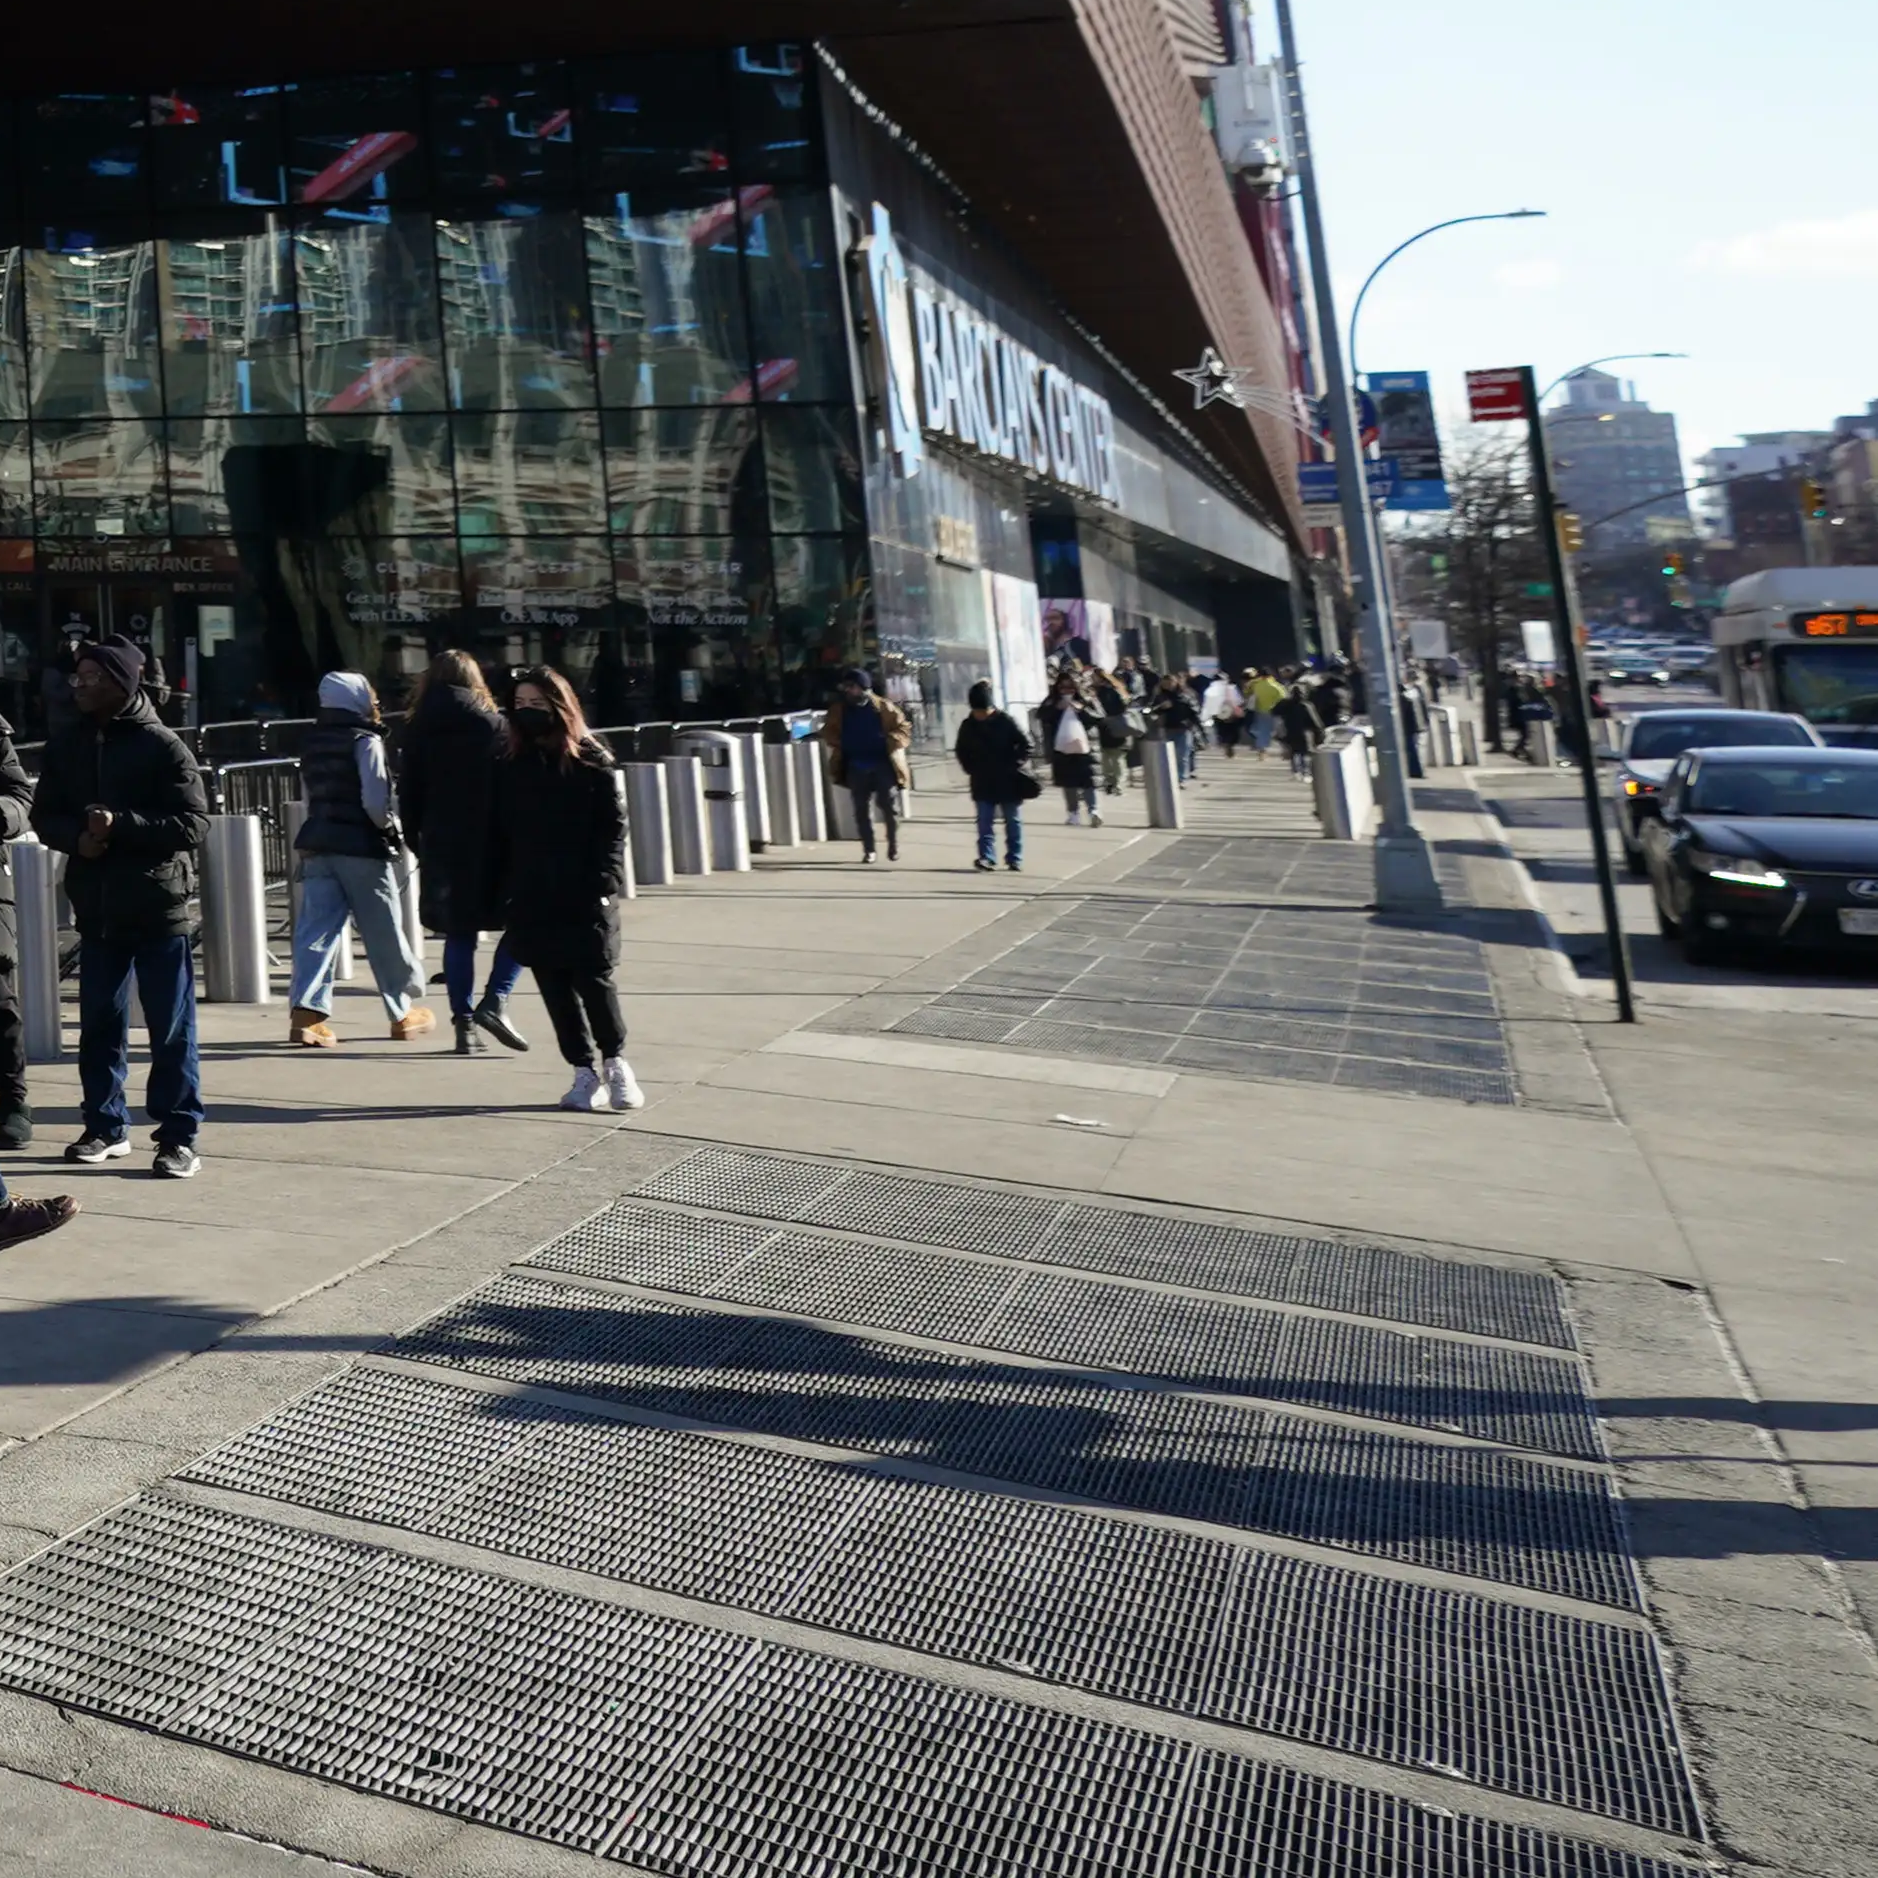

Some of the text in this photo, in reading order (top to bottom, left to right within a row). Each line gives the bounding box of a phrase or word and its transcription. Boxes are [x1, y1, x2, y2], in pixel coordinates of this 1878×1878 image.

[913, 287, 1123, 509] BARCLAYS CENTER
[53, 556, 214, 572] MAIN ENTRANCE
